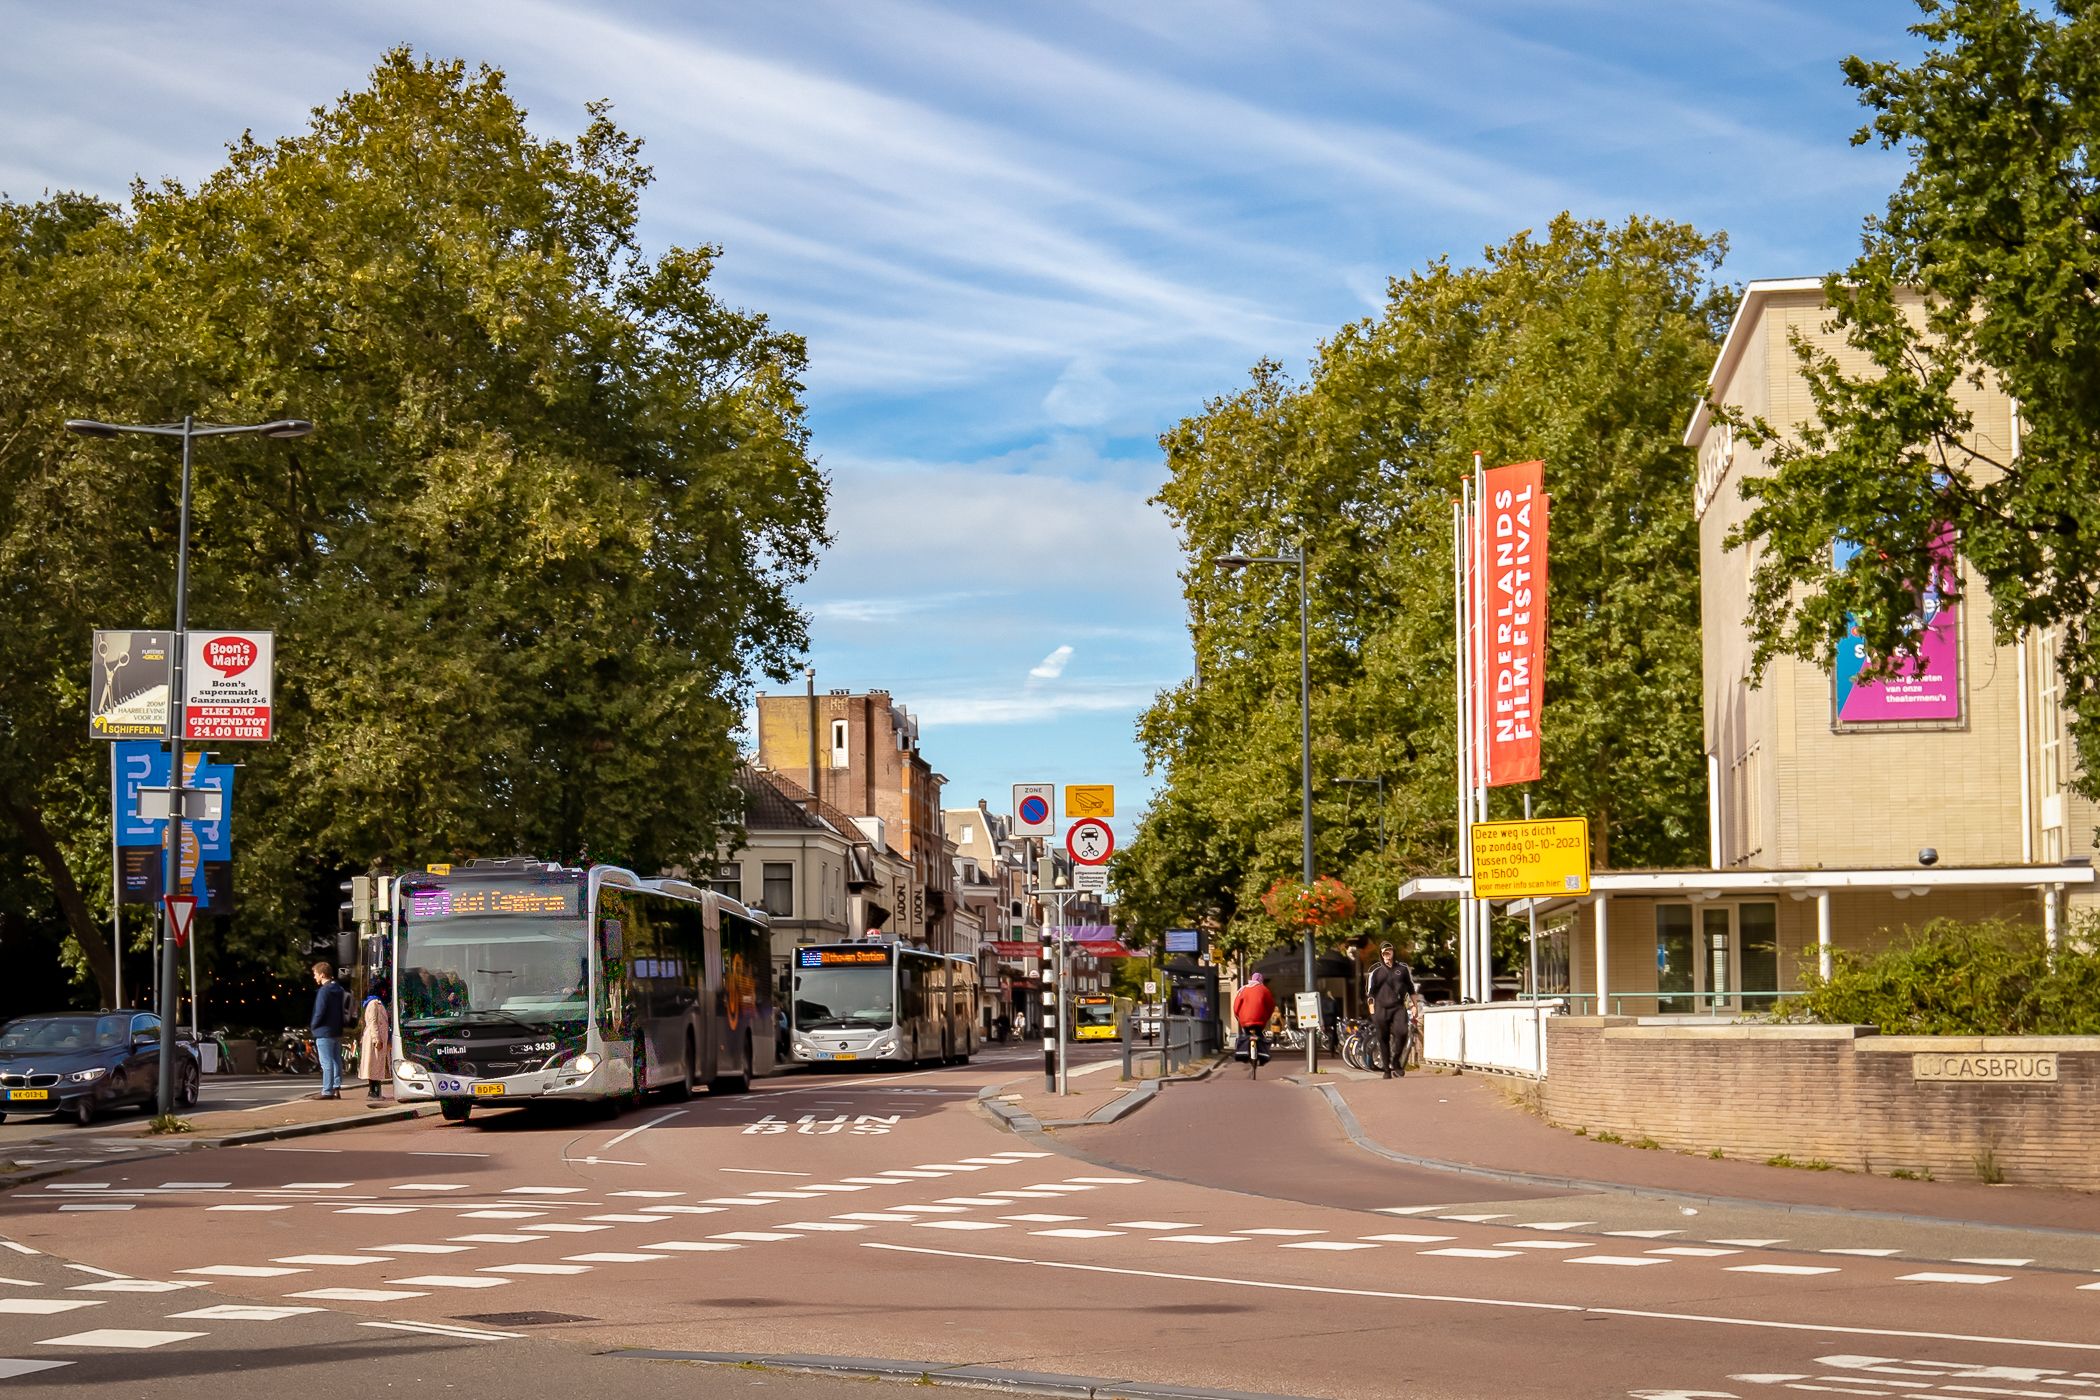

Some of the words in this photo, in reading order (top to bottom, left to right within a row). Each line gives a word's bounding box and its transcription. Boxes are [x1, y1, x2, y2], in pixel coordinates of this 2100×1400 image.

[1513, 484, 1533, 645] FESTIVAL
[1496, 489, 1514, 742] NEDERLANDS
[210, 642, 250, 655] Boon's
[213, 654, 250, 666] Markt
[199, 689, 258, 697] supermarkt
[1513, 657, 1533, 740] FILM
[190, 696, 250, 704] Ganzemarkt
[201, 707, 231, 716] ELKE
[232, 707, 255, 716] DAG
[189, 717, 244, 726] GEOPEND
[245, 717, 267, 726] TOT
[108, 725, 164, 735] SCHIFFER.NL
[193, 726, 232, 737] 24.00
[234, 726, 263, 737] UUR
[1475, 829, 1498, 839] Deze
[1500, 829, 1519, 840] weg
[1521, 827, 1529, 837] is
[1531, 825, 1556, 836] dicht
[1475, 844, 1487, 854] op
[1489, 841, 1522, 853] zondag
[1476, 856, 1507, 866] tussen
[1509, 853, 1541, 865] 09h30
[1477, 871, 1489, 879] en
[1491, 867, 1519, 879] 15h00
[1494, 882, 1511, 890] meer
[856, 951, 886, 962] Station
[437, 1046, 467, 1055] u-link.nl
[535, 1042, 556, 1051] 3439
[1919, 1057, 2052, 1077] LUCASBRUG
[741, 1124, 893, 1135] BUS
